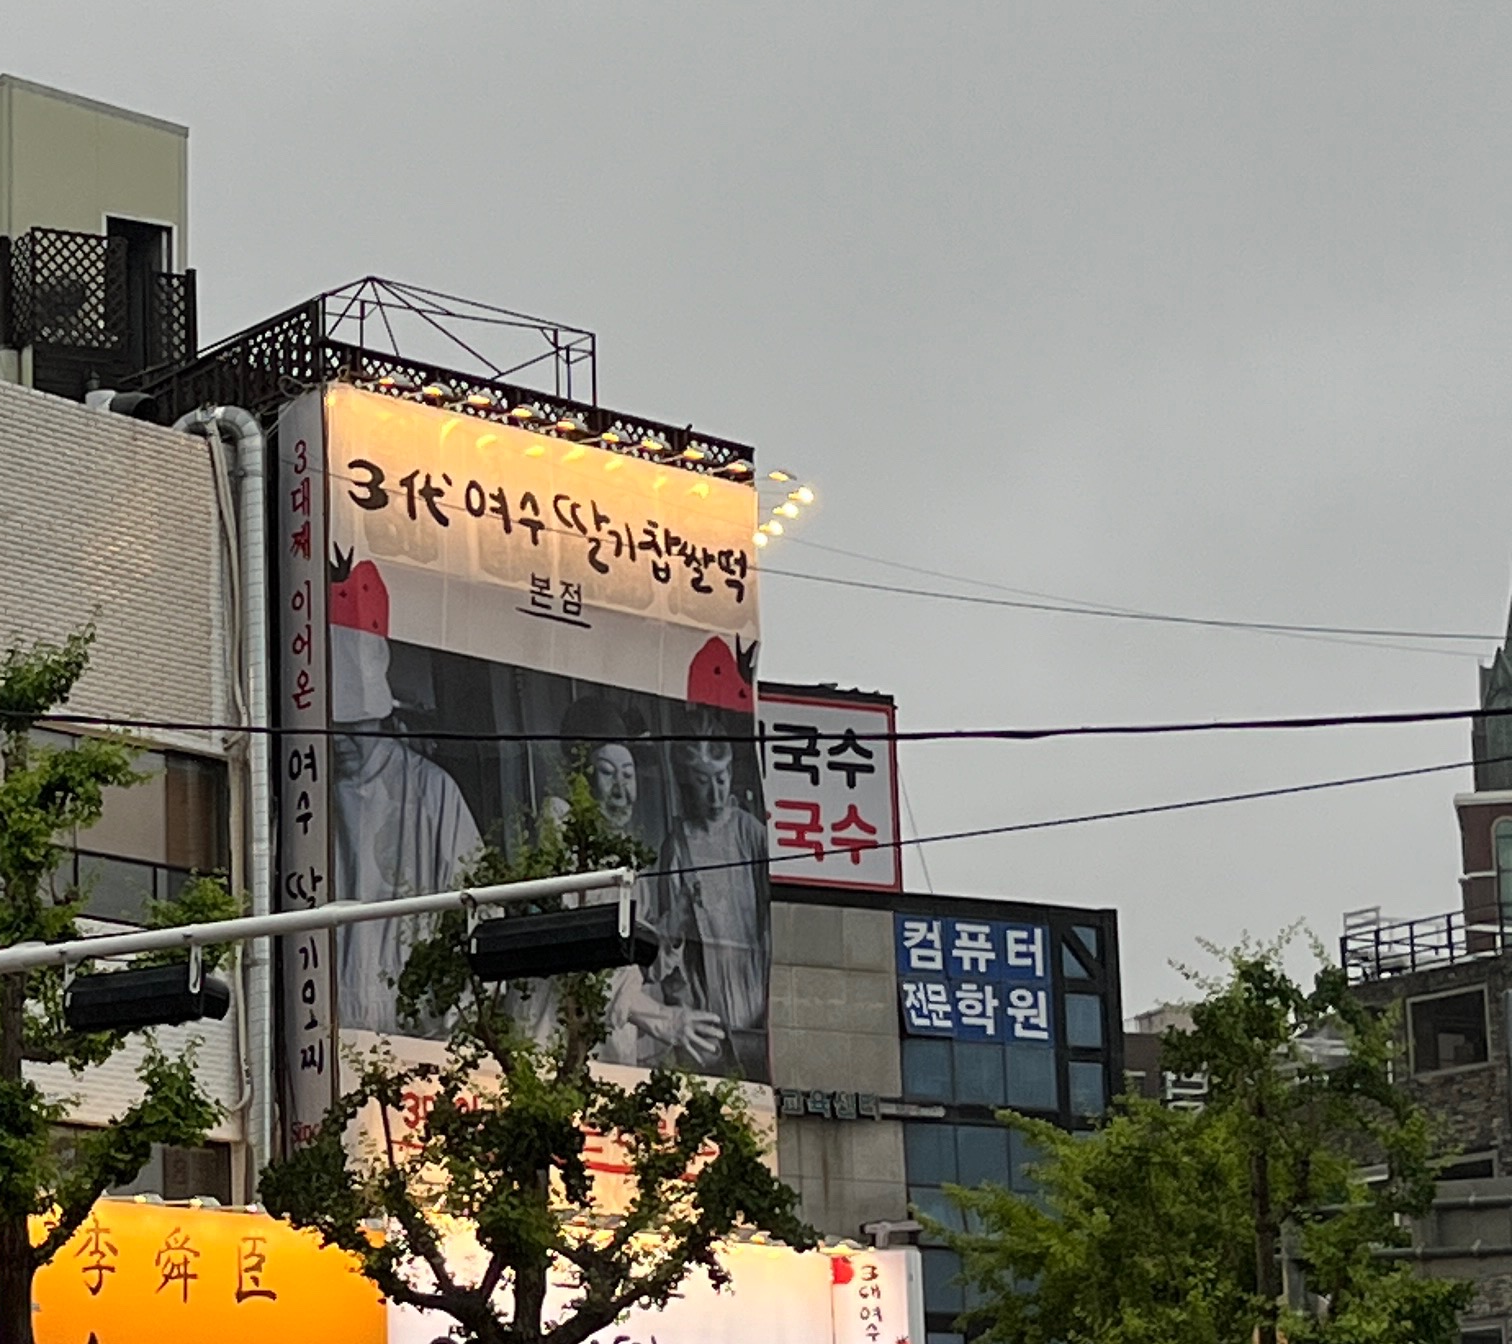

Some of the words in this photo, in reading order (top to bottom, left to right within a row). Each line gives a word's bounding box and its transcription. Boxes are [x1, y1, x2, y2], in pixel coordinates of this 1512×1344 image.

[529, 571, 583, 615] 본점
[759, 720, 876, 790] 국수
[902, 919, 1046, 978] 컴퓨터
[902, 980, 1050, 1041] 전문학원
